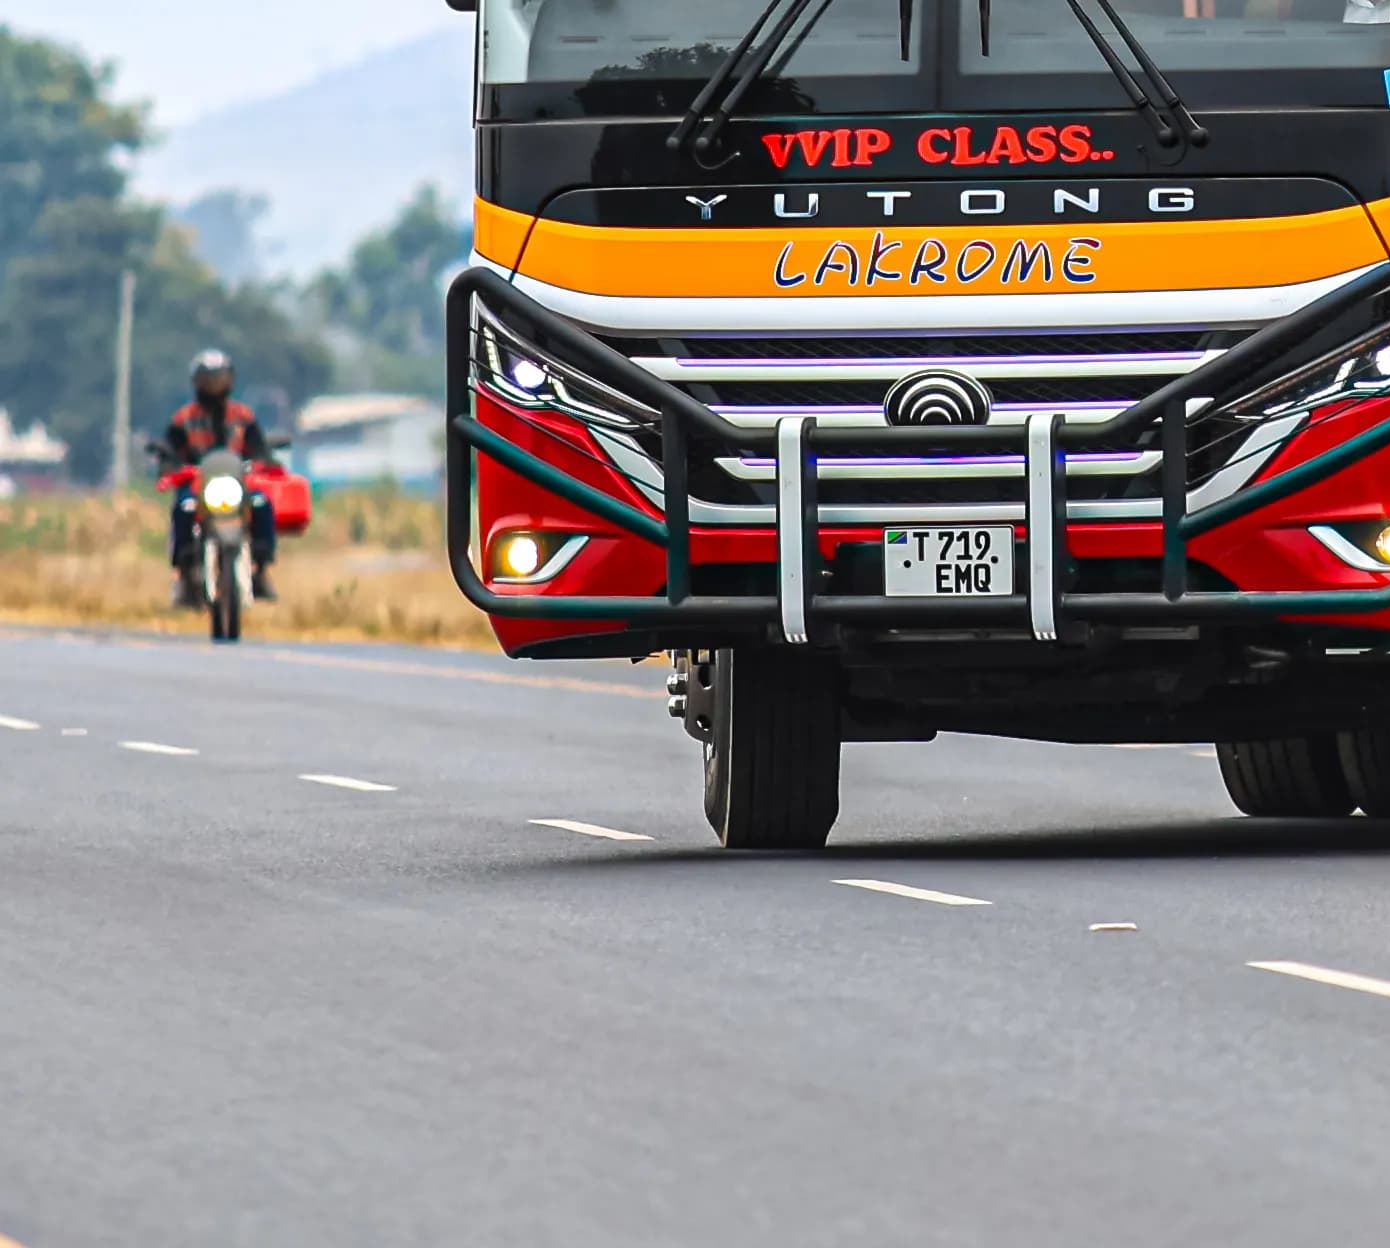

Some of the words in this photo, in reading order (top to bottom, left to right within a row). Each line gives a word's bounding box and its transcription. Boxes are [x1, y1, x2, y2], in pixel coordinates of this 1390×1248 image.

[761, 129, 892, 169] VVIP
[684, 186, 1197, 221] YUTONG
[773, 230, 1102, 288] LAKROME
[912, 531, 930, 562] T
[937, 530, 991, 561] 719
[935, 563, 992, 594] EMQ
